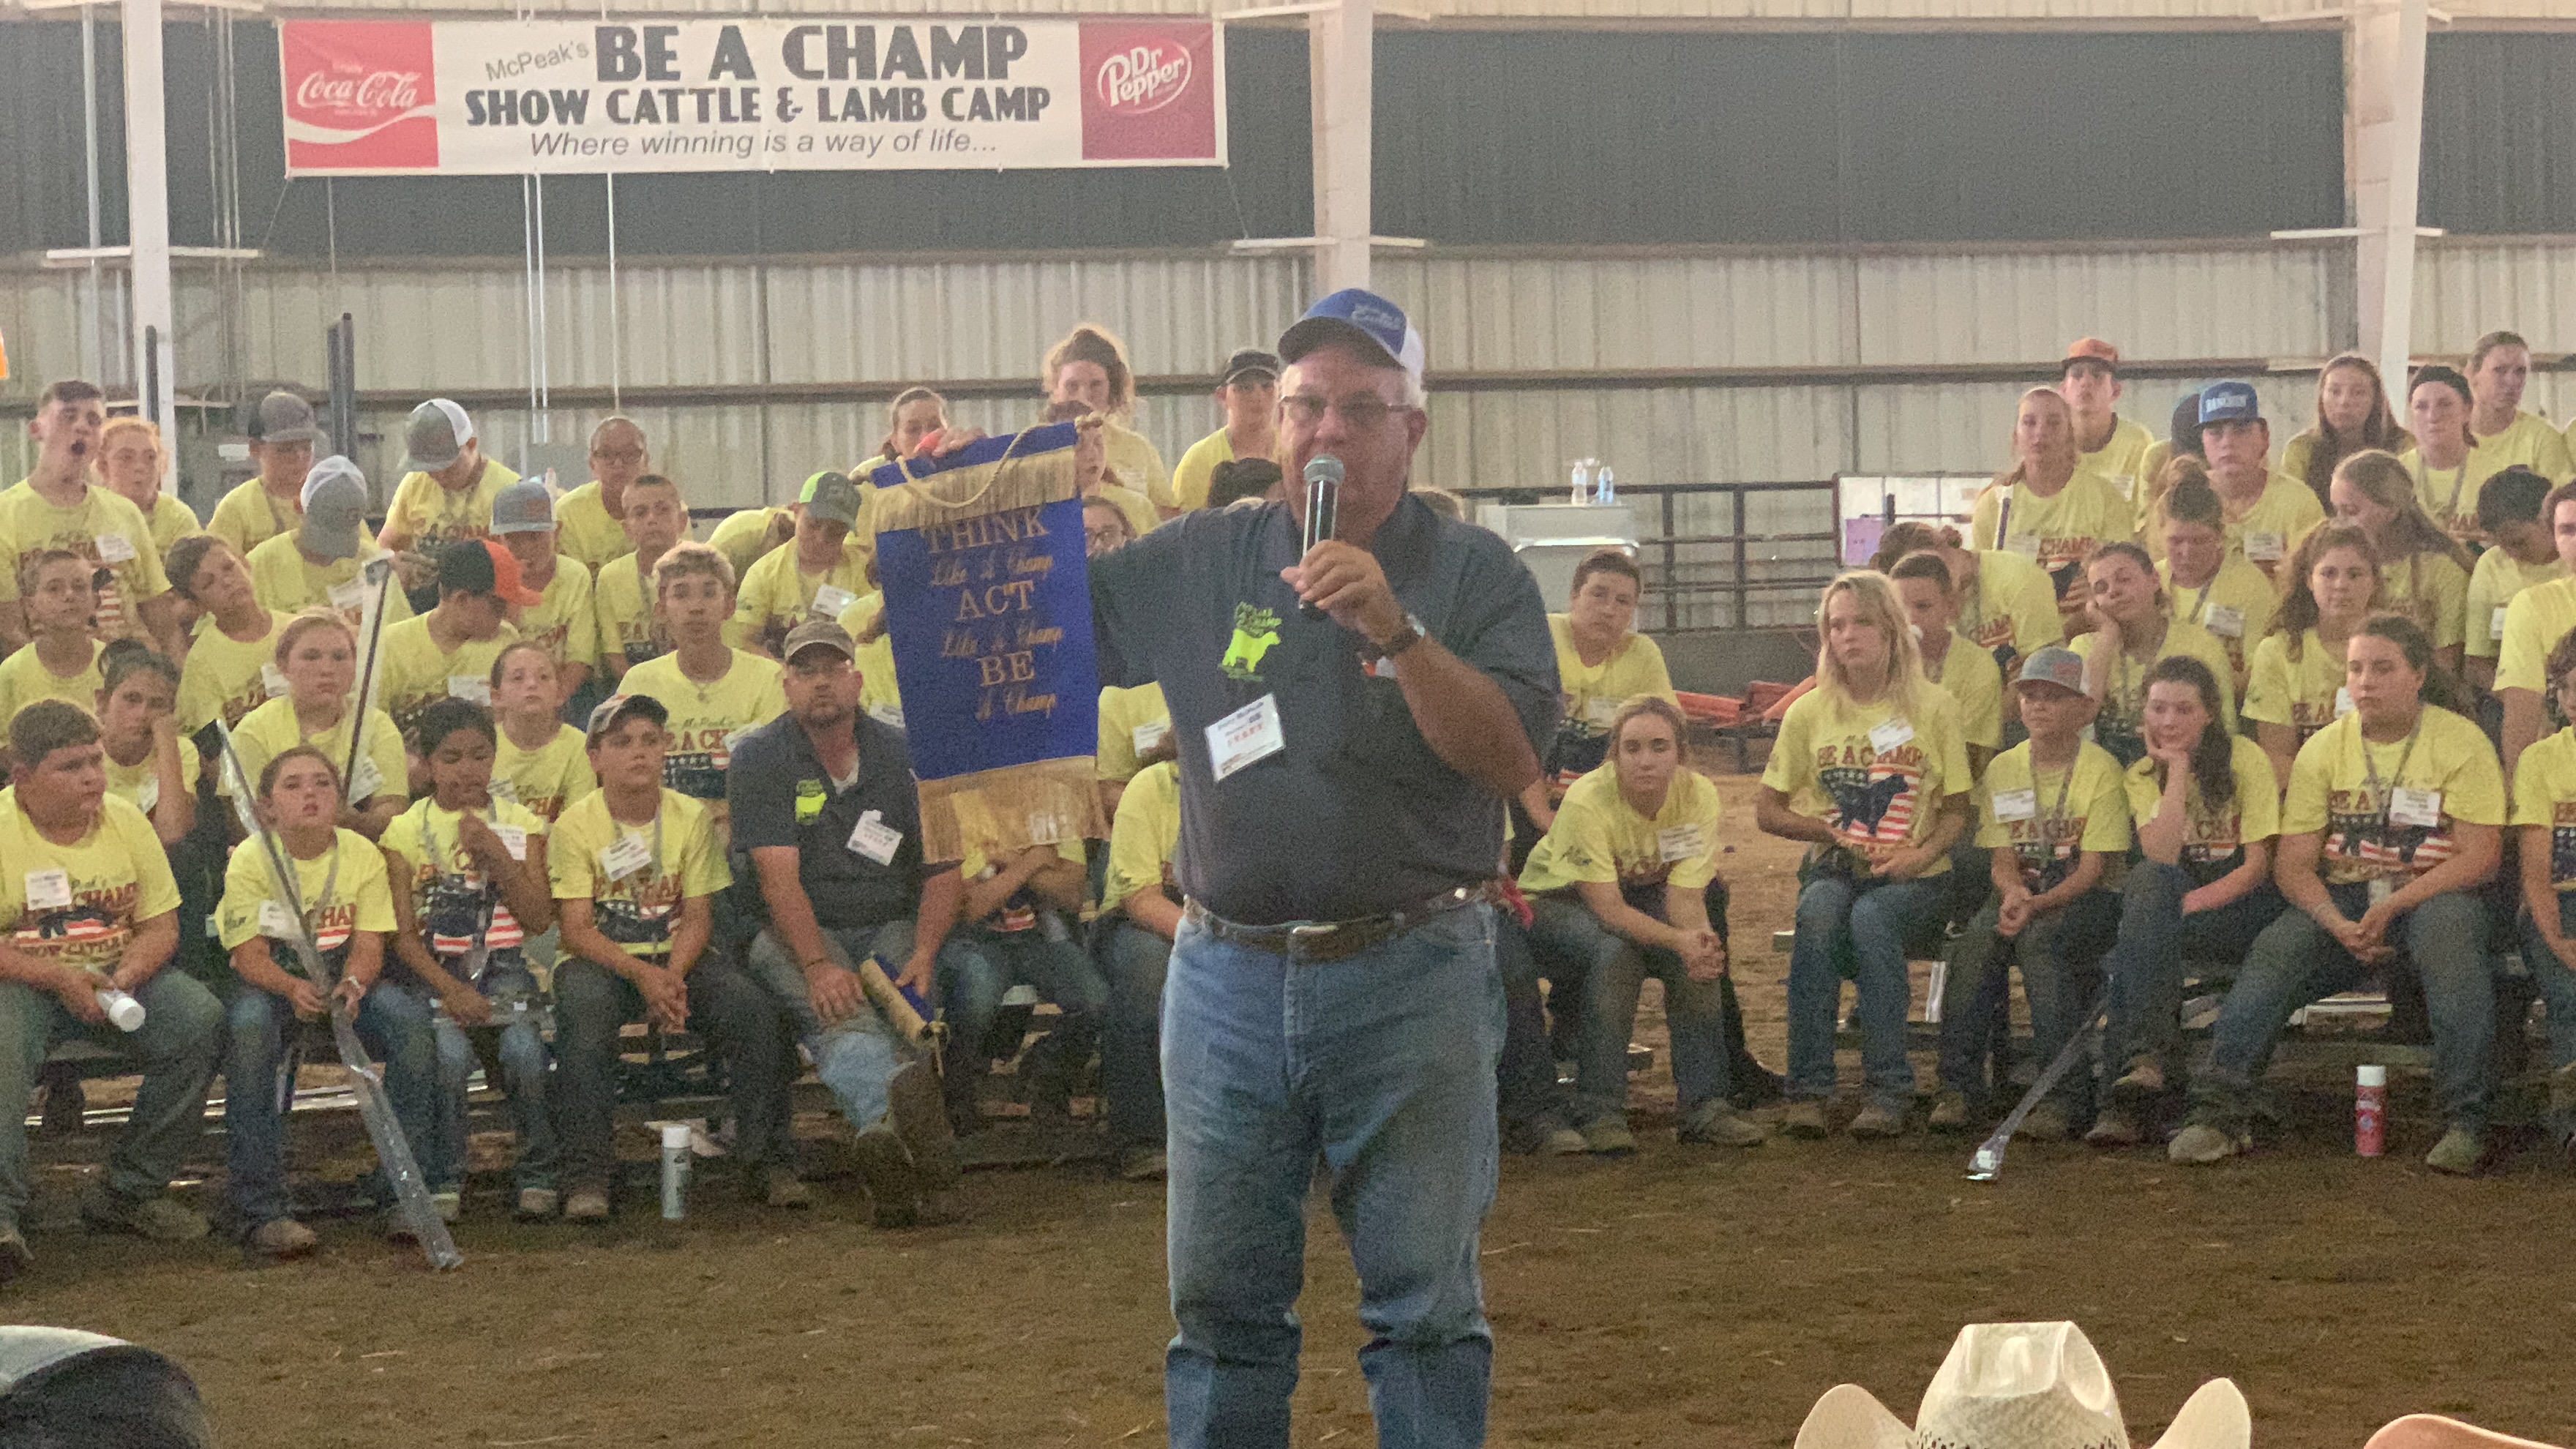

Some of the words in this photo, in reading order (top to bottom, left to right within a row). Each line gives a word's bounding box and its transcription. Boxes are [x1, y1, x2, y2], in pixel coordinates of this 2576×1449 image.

[485, 41, 590, 82] McPeak's
[595, 26, 681, 82] BE
[708, 25, 757, 80] A
[782, 25, 1028, 80] CHAMP
[1130, 47, 1163, 78] Dr
[297, 72, 421, 108] Coca-Cola
[1098, 54, 1185, 107] Pepper
[465, 89, 591, 126] SHOW
[606, 87, 761, 124] CATTLE
[776, 86, 804, 124] &
[817, 86, 926, 123] LAMB
[941, 86, 1050, 122] CAMP
[531, 132, 629, 157] Where
[641, 130, 753, 159] winning
[764, 130, 787, 152] is
[797, 134, 814, 152] a
[825, 134, 884, 159] way
[893, 128, 924, 152] of
[929, 128, 996, 152] life...
[919, 506, 1052, 554] THINK
[955, 580, 1036, 621] ACT
[977, 650, 1036, 686] BE
